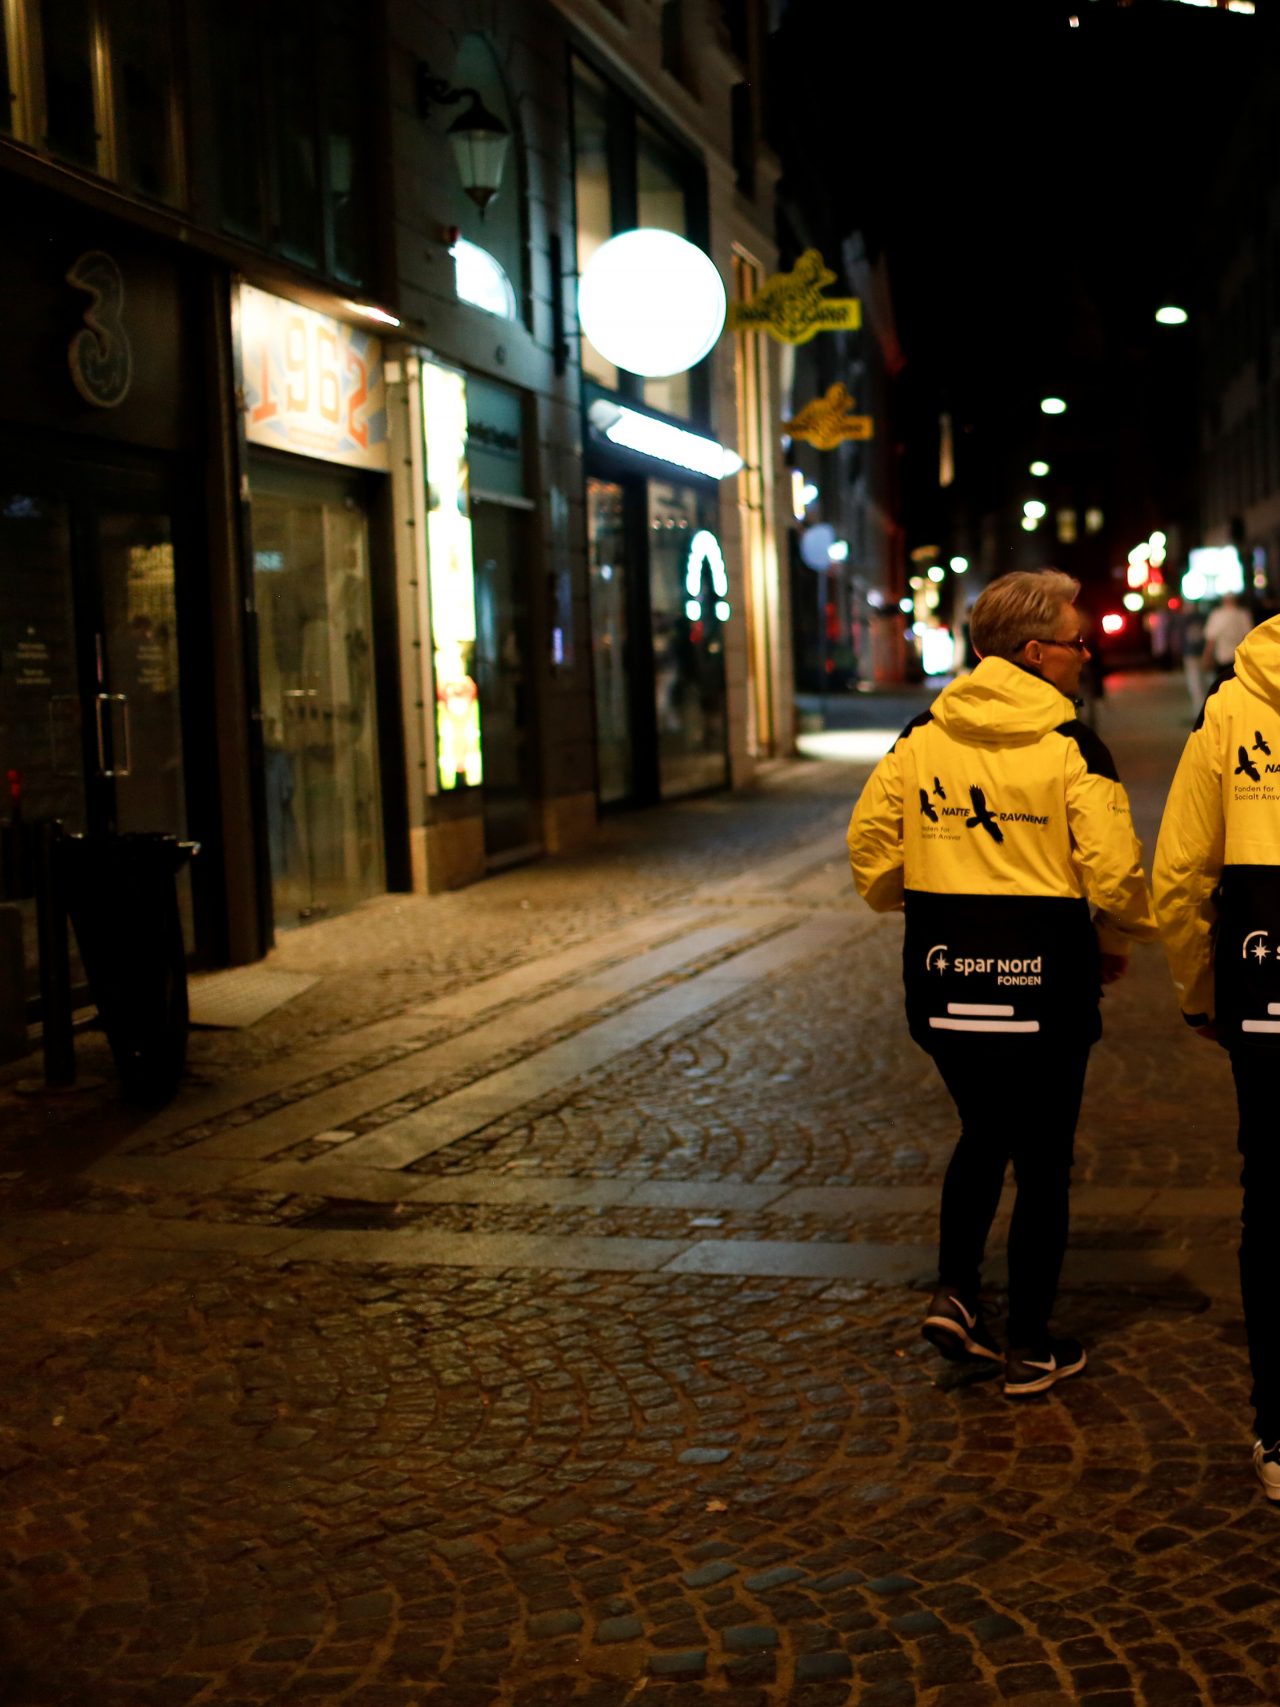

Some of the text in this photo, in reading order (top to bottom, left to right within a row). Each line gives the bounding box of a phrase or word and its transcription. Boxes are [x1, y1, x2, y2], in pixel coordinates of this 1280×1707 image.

[249, 316, 369, 449] 1962
[942, 807, 971, 817] NATTE
[954, 958, 995, 976] spar
[997, 976, 1042, 986] FONDEN
